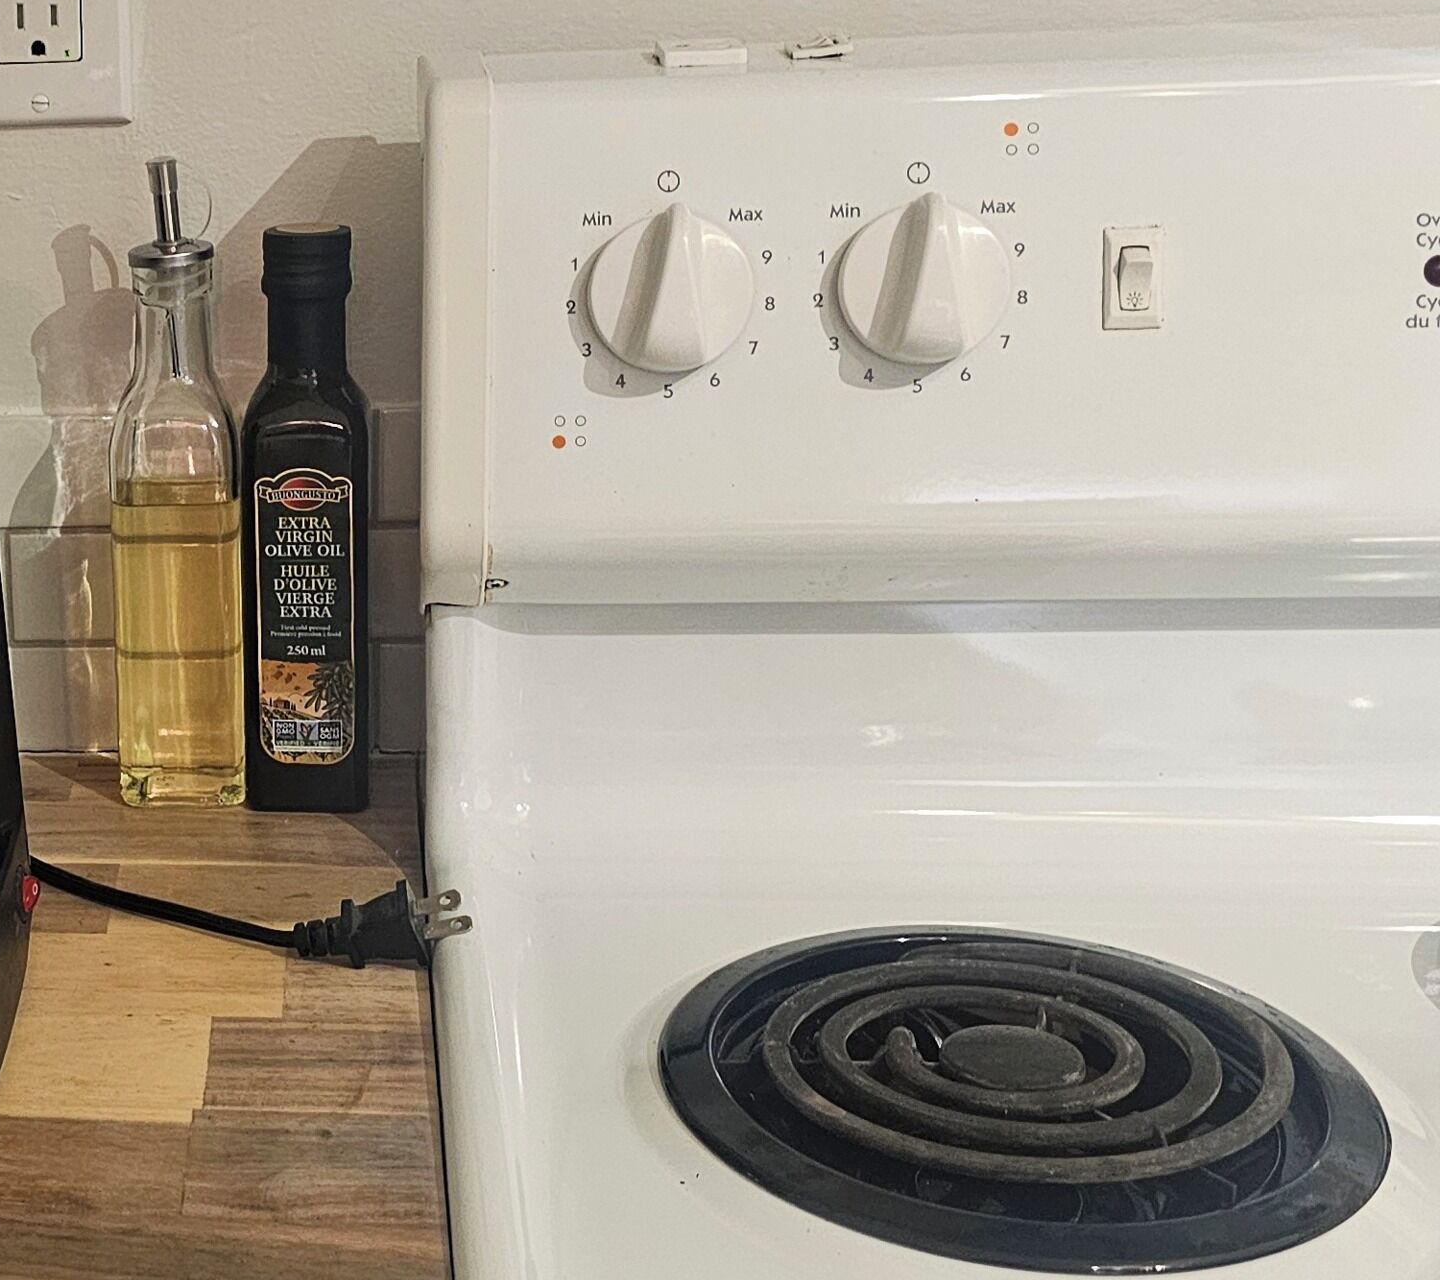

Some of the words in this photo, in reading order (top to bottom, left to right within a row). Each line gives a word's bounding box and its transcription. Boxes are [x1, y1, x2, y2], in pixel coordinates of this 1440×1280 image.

[830, 203, 860, 218] Min
[981, 200, 1016, 214] Max
[582, 211, 612, 227] Min
[729, 208, 763, 222] Max
[1416, 232, 1440, 250] Cy
[762, 250, 772, 264] 9
[818, 250, 825, 264] 1
[1014, 243, 1025, 257] 9
[571, 257, 578, 271] 1
[765, 296, 775, 310] 8
[813, 293, 823, 308] 2
[1017, 290, 1028, 304] 8
[1416, 294, 1440, 312] Cy
[566, 300, 576, 314] 2
[1406, 314, 1429, 328] du
[749, 341, 758, 355] 7
[829, 337, 839, 351] 3
[1000, 335, 1010, 349] 7
[582, 343, 592, 357] 3
[616, 374, 626, 388] 4
[710, 373, 720, 387] 6
[864, 368, 874, 382] 4
[960, 367, 971, 381] 6
[664, 384, 673, 398] 5
[912, 379, 922, 393] 5
[272, 490, 336, 501] BUONGUSTO
[278, 517, 331, 529] EXTRA
[276, 530, 333, 543] VIRGIN
[265, 545, 312, 557] OLIVE
[317, 545, 345, 557] OIL
[281, 565, 330, 577] HUILE
[274, 578, 337, 591] D'OLIVE
[276, 592, 335, 605] VIERGE
[280, 606, 332, 618] EXTRA
[286, 645, 309, 656] 250
[310, 645, 326, 656] ml
